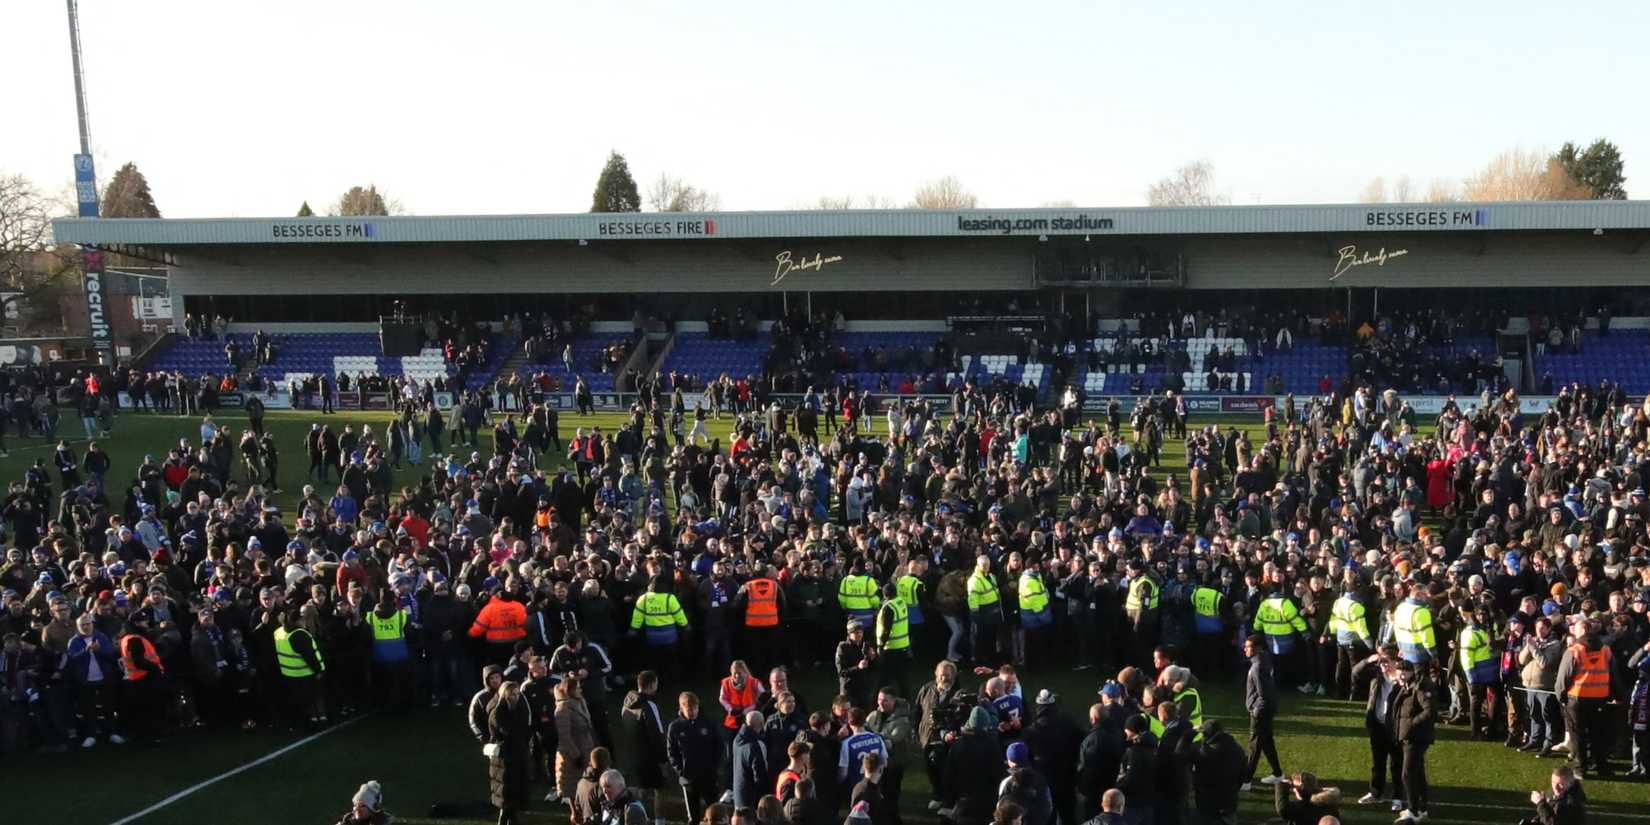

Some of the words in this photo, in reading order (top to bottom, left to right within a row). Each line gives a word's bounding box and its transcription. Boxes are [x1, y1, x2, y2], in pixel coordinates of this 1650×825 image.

[958, 216, 1048, 233] leasing.com
[1051, 214, 1113, 230] stadium
[1366, 211, 1448, 225] BESSEGES
[1453, 211, 1472, 224] FM
[272, 224, 341, 238] BESSEGES
[346, 224, 362, 237] FM
[599, 222, 672, 235] BESSEGES
[677, 220, 702, 234] FIRE
[86, 272, 109, 338] recruit
